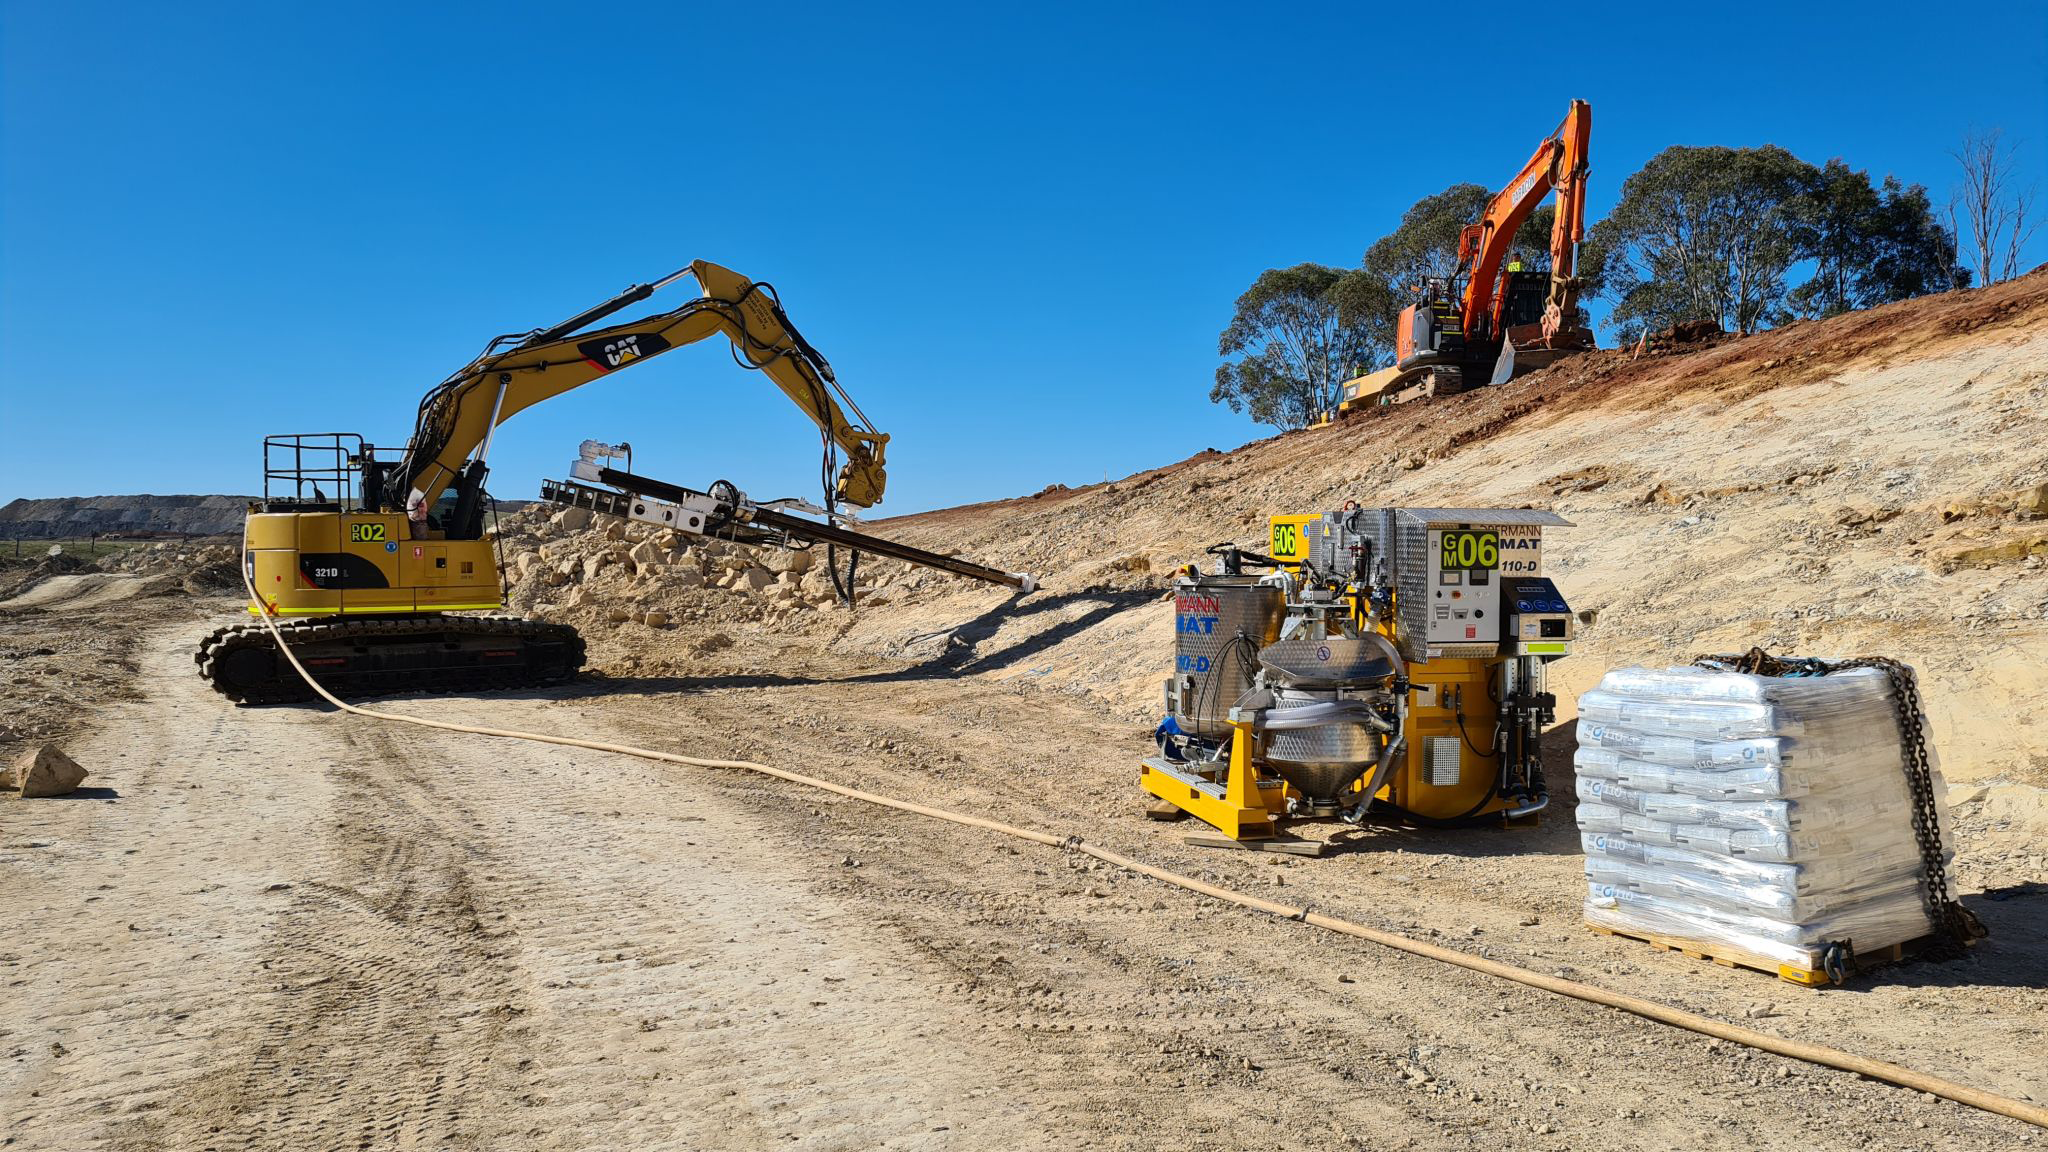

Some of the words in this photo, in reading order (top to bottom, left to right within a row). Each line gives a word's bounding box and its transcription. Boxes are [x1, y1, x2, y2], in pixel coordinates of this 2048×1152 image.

[605, 335, 641, 366] CAT
[360, 524, 385, 541] 02
[1480, 525, 1540, 536] RMANN
[1280, 526, 1295, 553] 06
[1500, 538, 1541, 549] MAT
[1458, 533, 1498, 567] 06
[315, 568, 338, 577] 321D
[1501, 560, 1537, 571] 110-D
